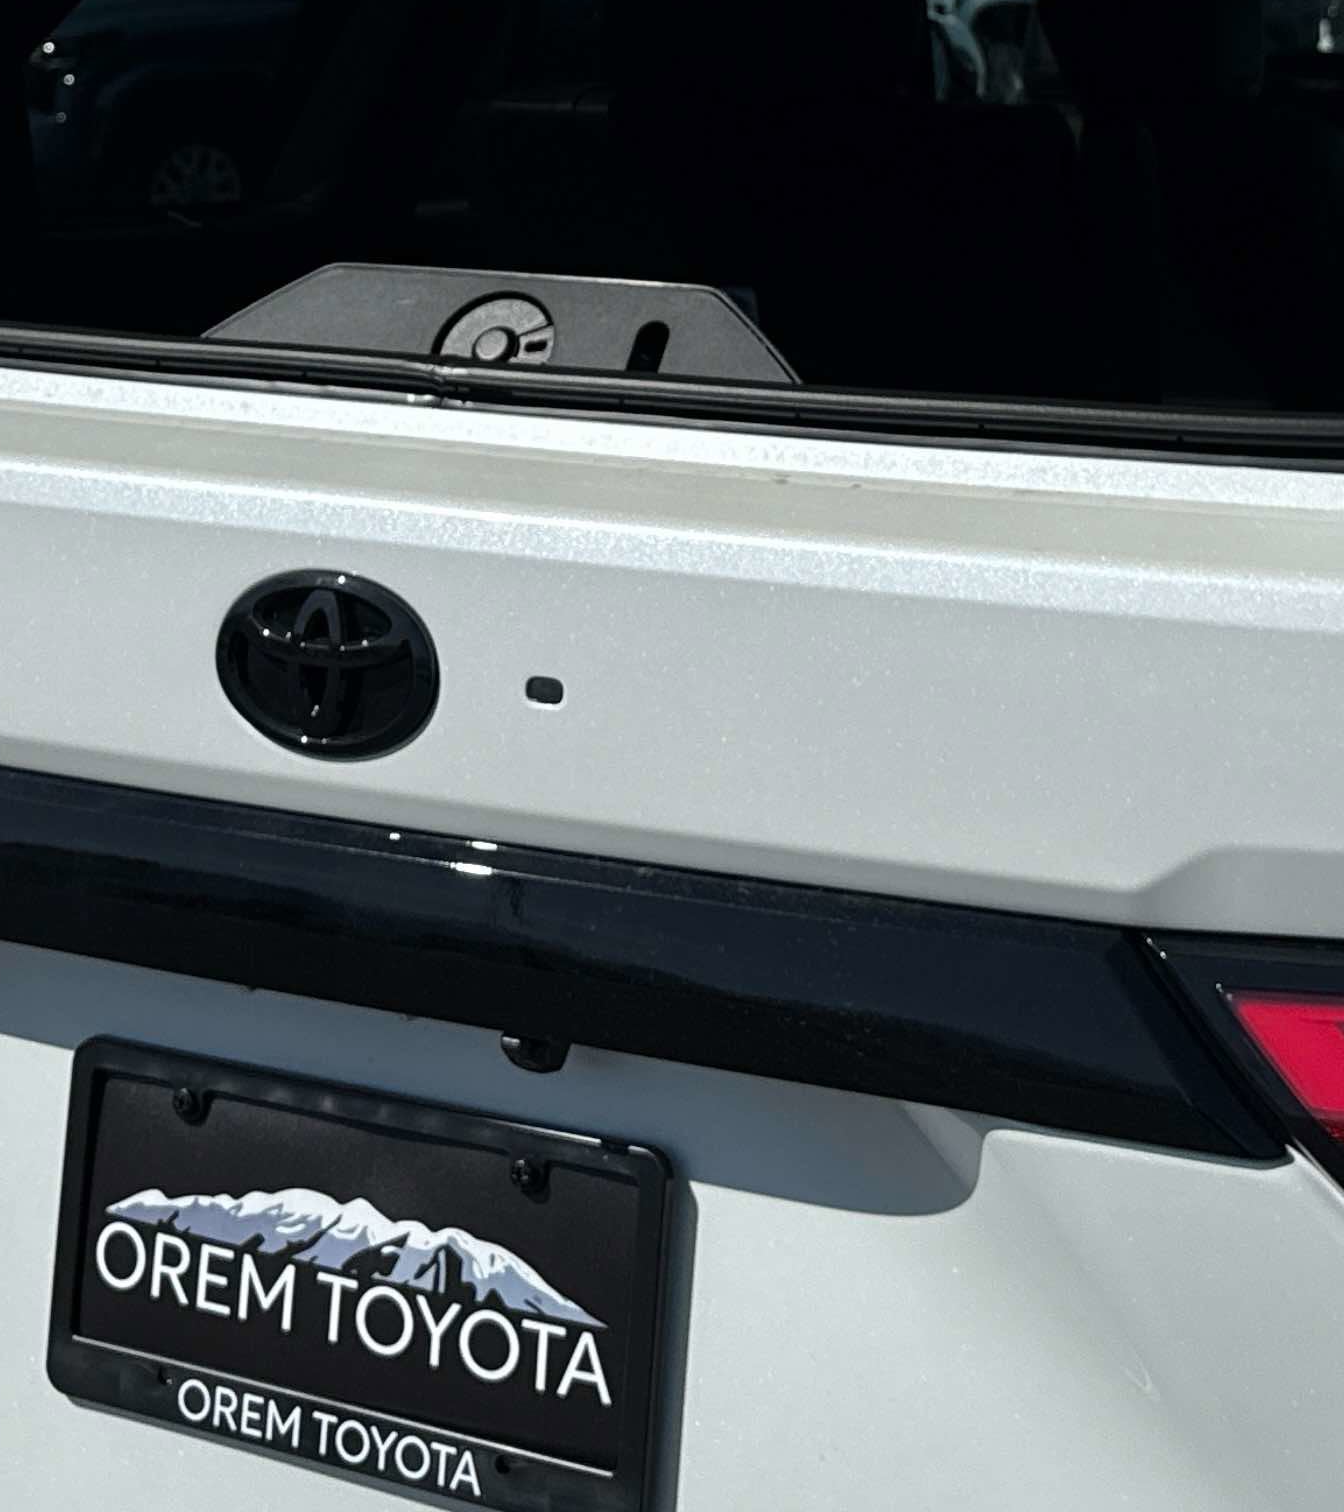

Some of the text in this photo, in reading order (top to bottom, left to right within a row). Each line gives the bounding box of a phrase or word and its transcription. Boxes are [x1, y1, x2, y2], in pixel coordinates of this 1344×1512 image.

[94, 1219, 613, 1406] OREM TOYOTA
[176, 1377, 482, 1497] OREM TOYOTA
